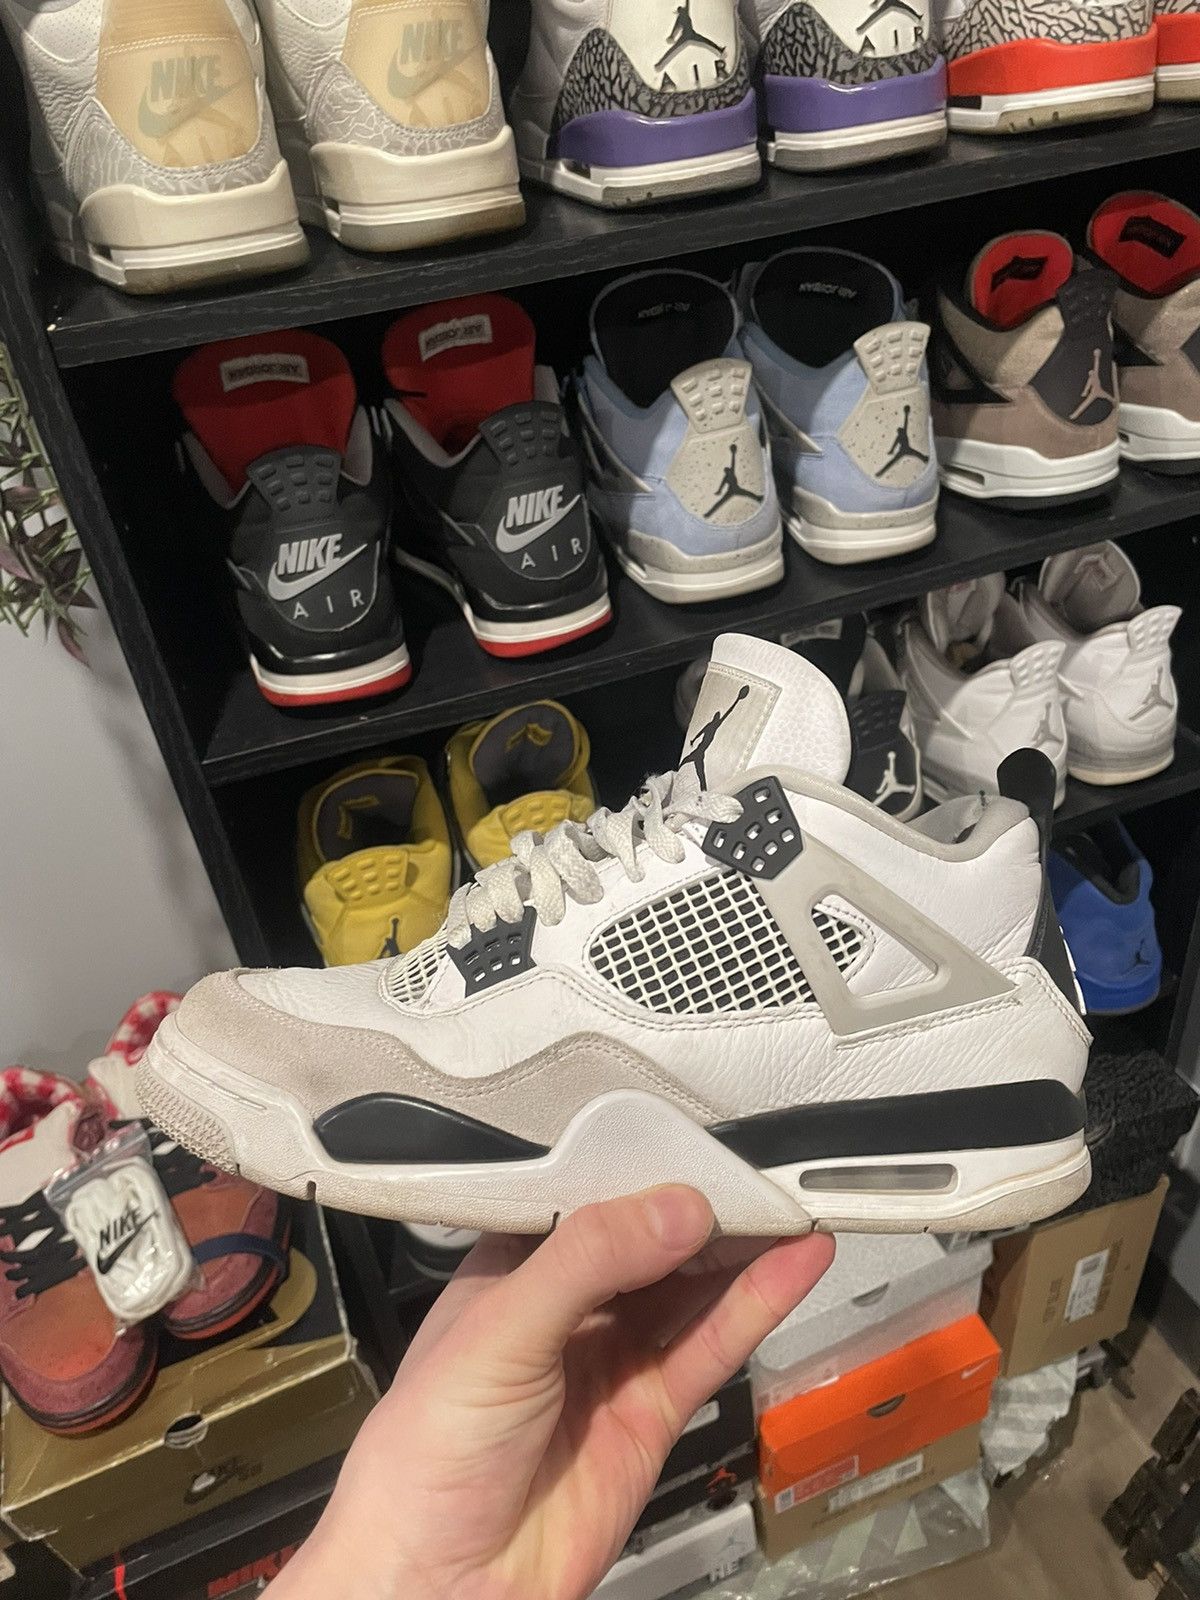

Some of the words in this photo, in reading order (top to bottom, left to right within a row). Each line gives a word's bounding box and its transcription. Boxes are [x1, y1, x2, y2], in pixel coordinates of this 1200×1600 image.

[399, 18, 466, 66] NIKE
[858, 25, 925, 55] AIR
[150, 54, 222, 102] NIKE
[659, 60, 730, 92] AIR
[505, 484, 564, 527] NIKE
[276, 533, 344, 576] NIKE
[520, 538, 584, 570] AIR
[291, 588, 366, 620] AIR
[100, 1207, 142, 1250] NIKE
